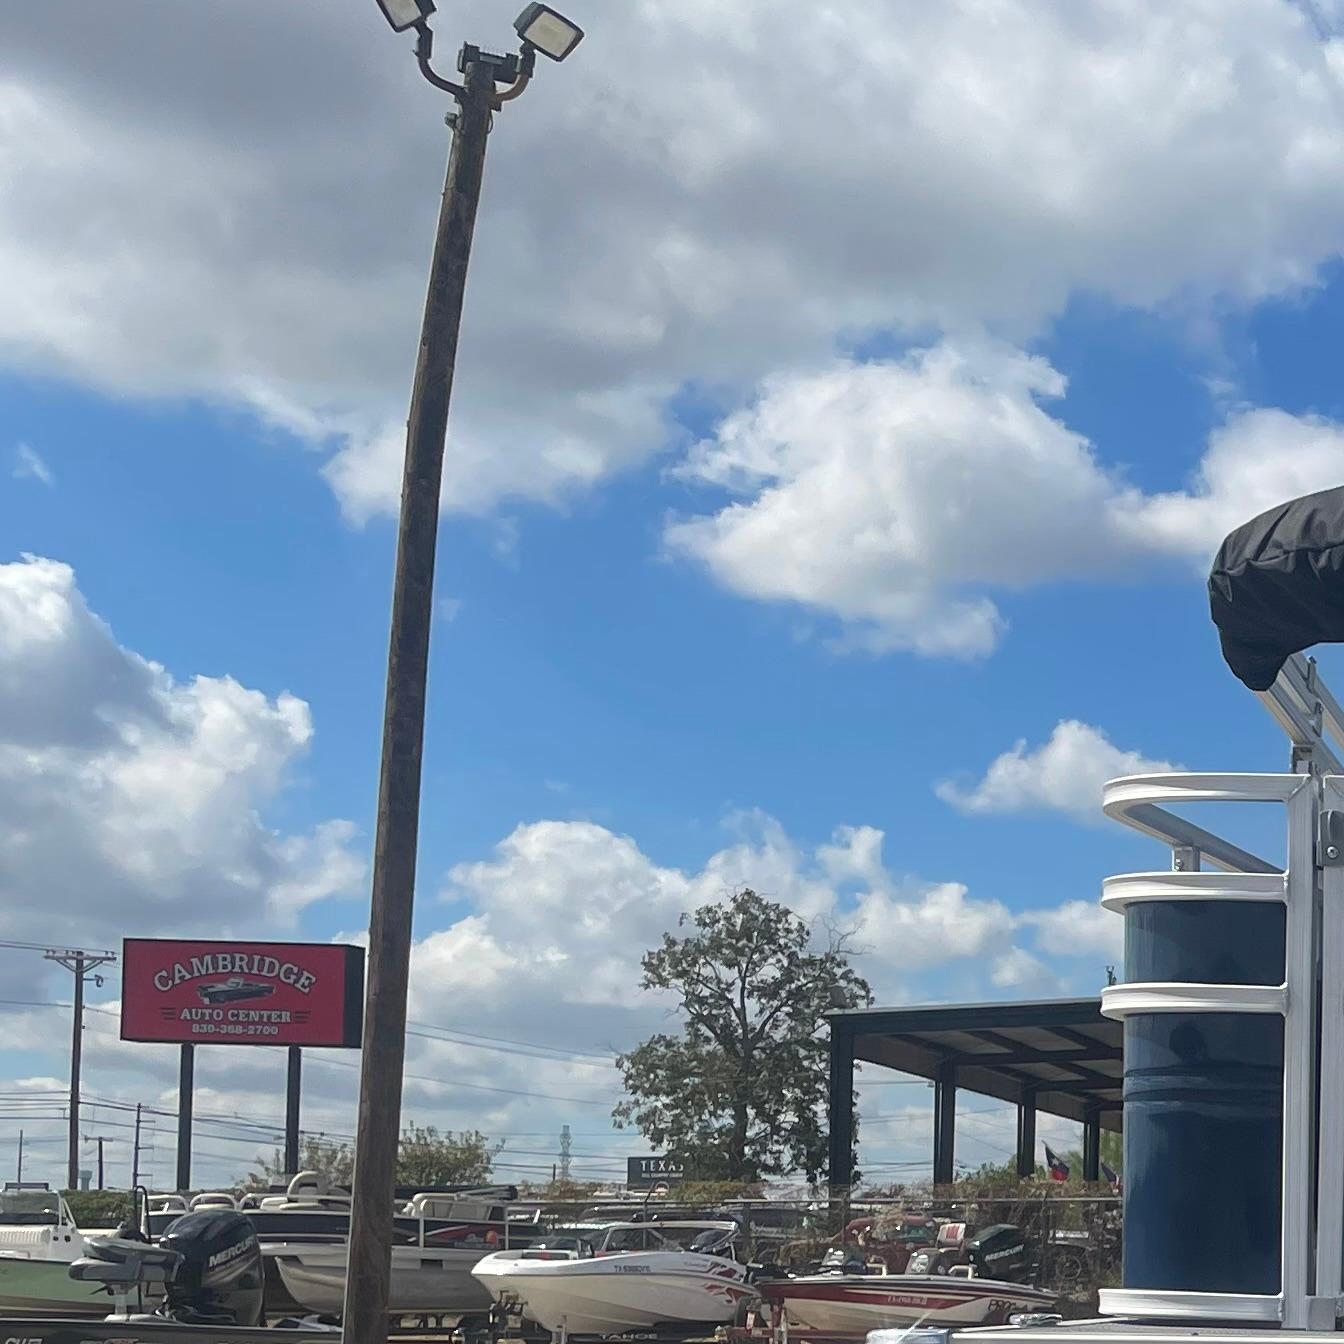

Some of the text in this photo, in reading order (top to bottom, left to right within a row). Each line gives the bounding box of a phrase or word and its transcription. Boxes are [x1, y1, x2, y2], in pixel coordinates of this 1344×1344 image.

[153, 952, 317, 994] CAMBRIDGE
[180, 1008, 291, 1023] AUTO CENTER
